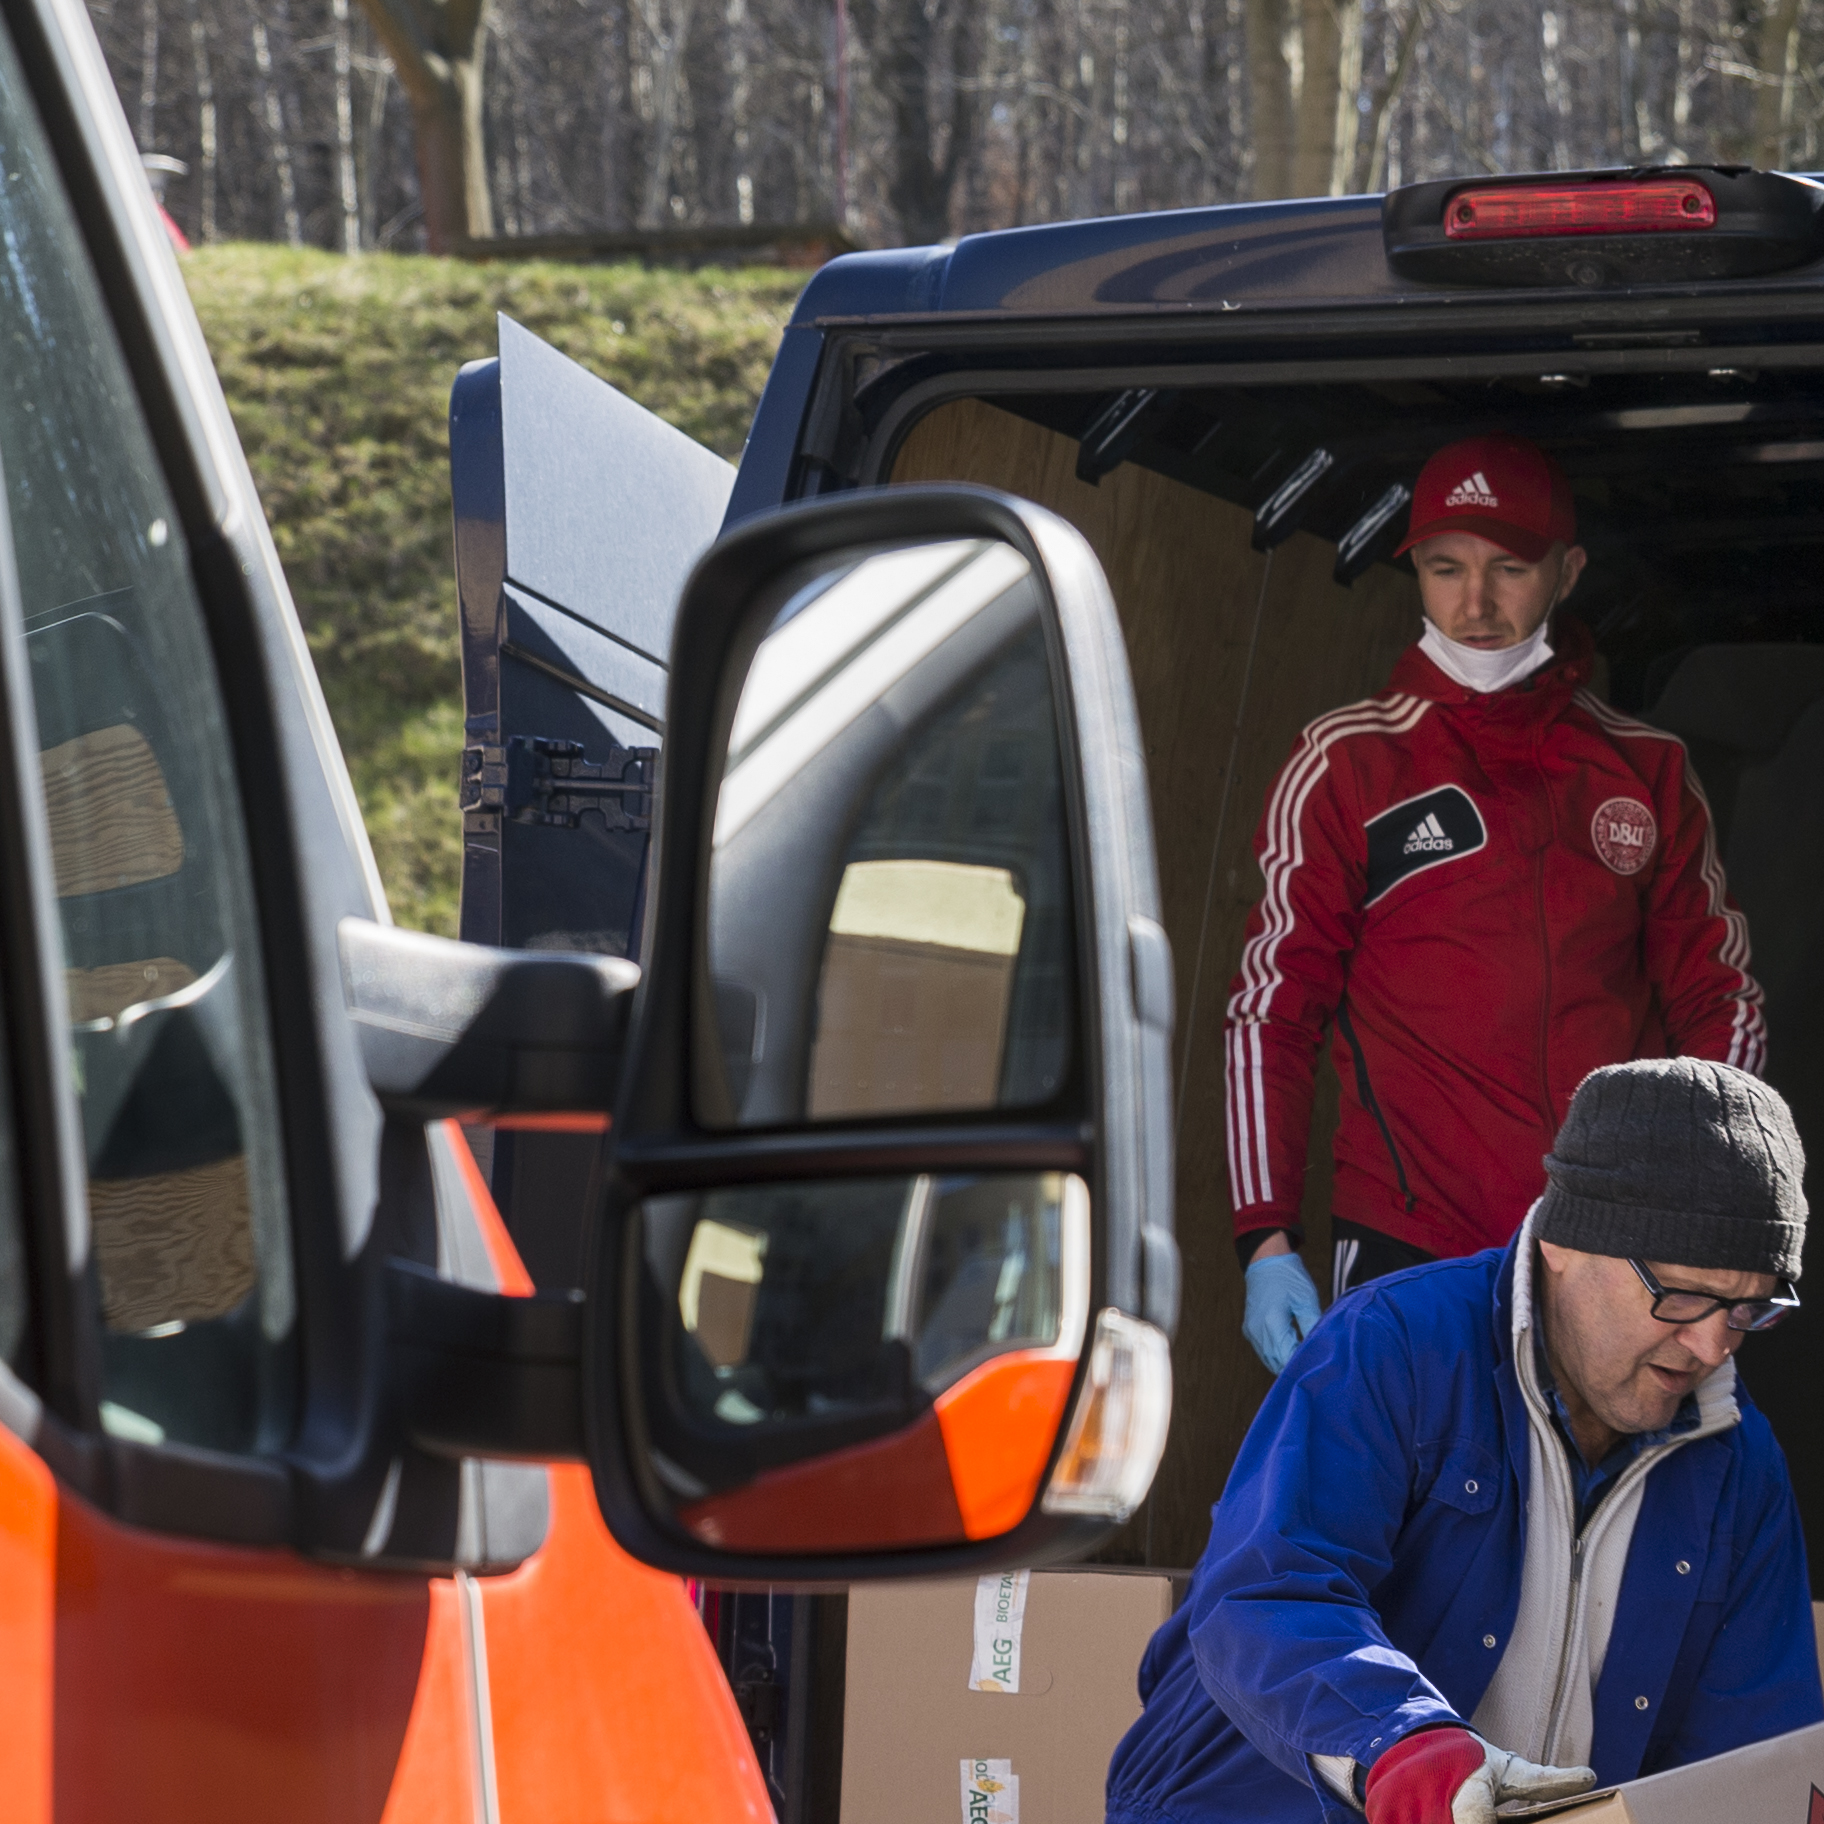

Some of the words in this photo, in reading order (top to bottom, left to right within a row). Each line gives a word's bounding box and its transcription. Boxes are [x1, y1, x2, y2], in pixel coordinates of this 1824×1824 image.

[1445, 492, 1498, 508] adidas
[1403, 836, 1453, 855] adidas
[1609, 822, 1643, 847] DBU
[996, 1571, 1014, 1623] BIOETA
[992, 1639, 1013, 1684] AEG
